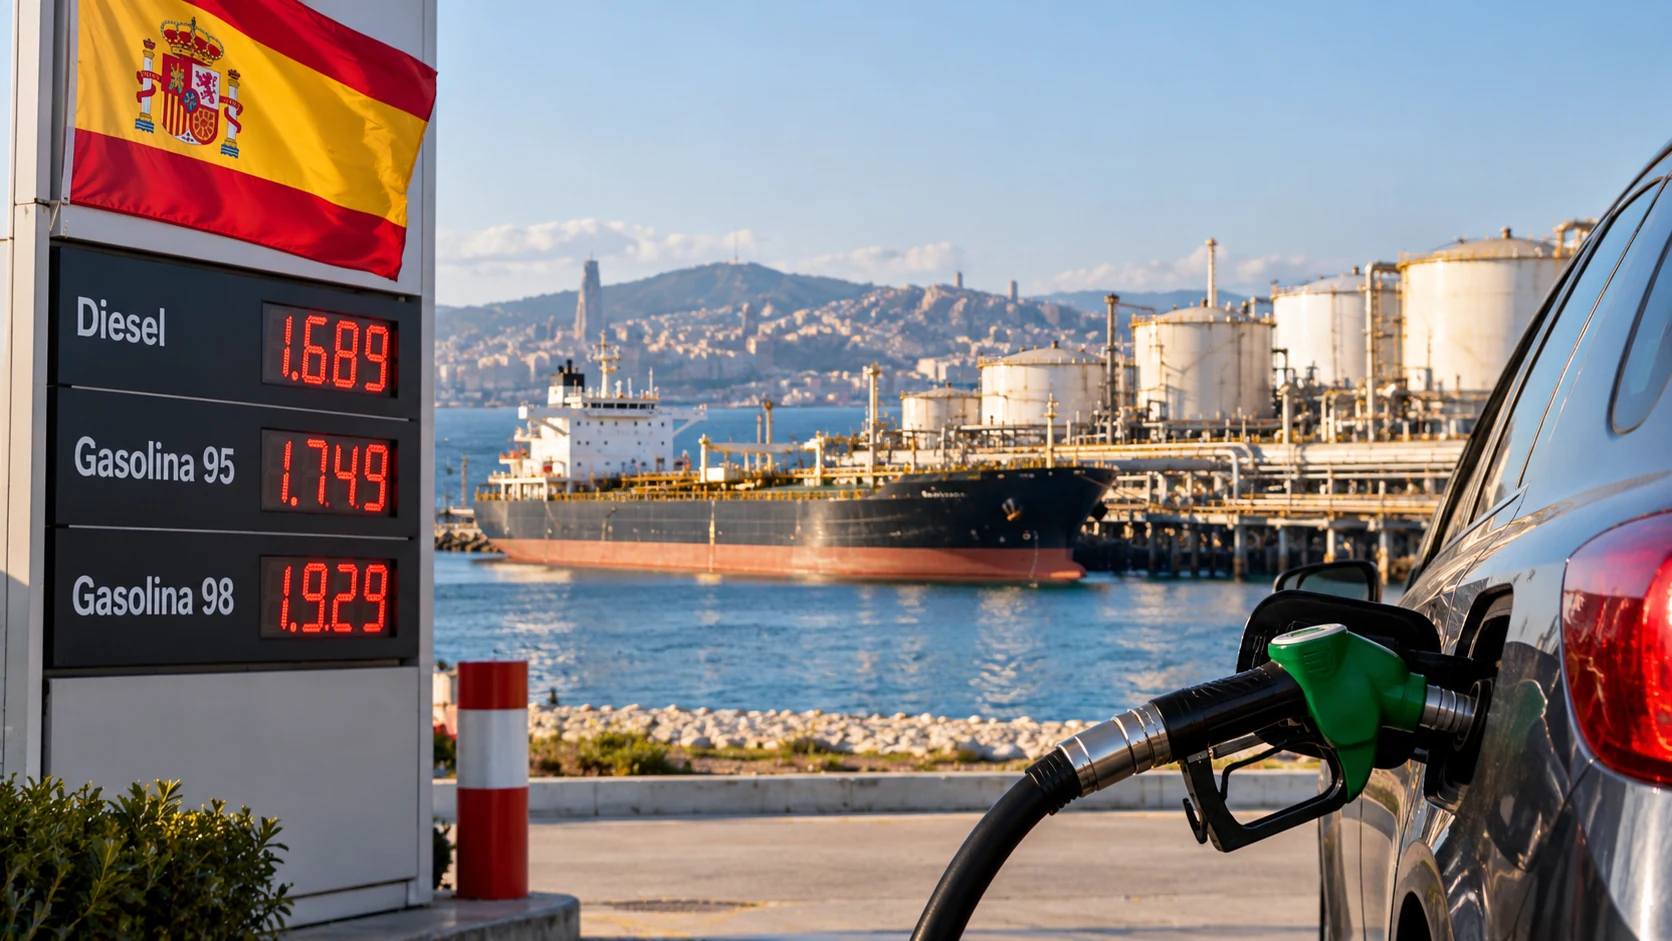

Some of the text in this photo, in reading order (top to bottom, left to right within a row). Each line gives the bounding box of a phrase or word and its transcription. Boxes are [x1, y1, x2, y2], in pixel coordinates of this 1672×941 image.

[77, 296, 166, 348] Diesel
[282, 314, 389, 393] 1.689
[74, 436, 235, 485] Gasolina 95
[72, 575, 234, 616] Gasolina 98
